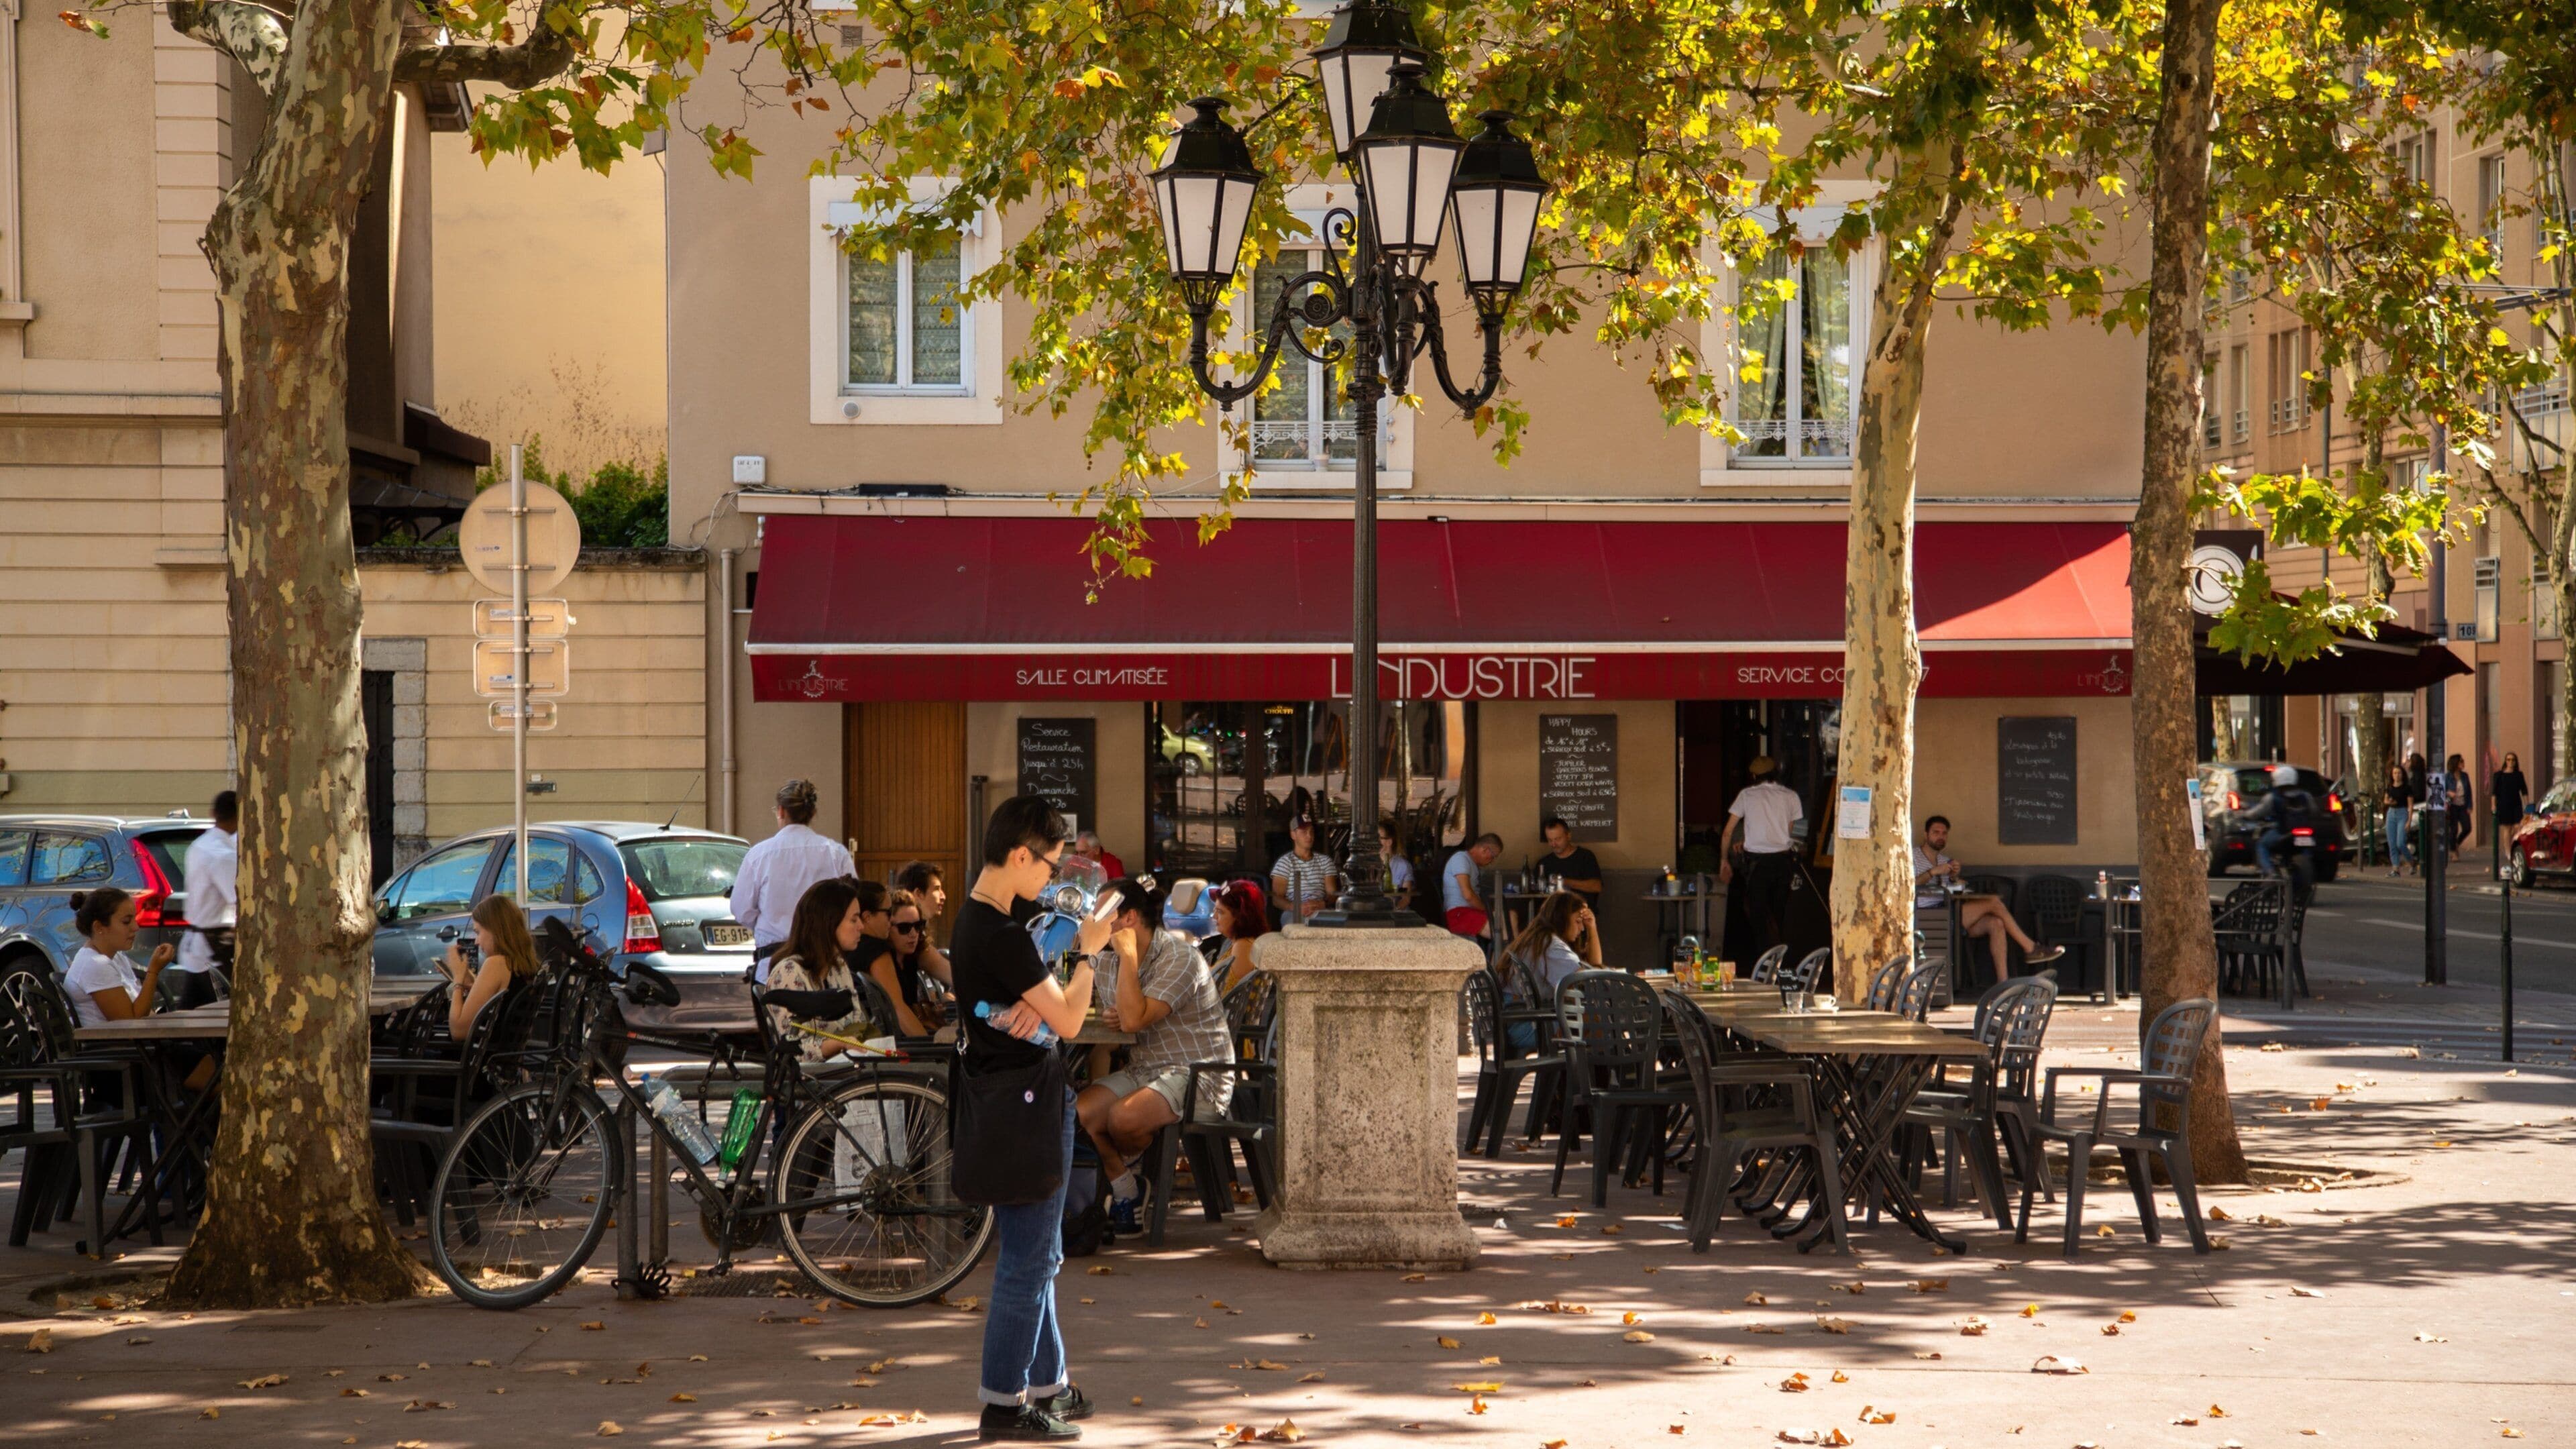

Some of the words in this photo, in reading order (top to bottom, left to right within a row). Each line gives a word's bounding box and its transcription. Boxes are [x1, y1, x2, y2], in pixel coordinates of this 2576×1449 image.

[1016, 669, 1067, 685] SALLE
[1073, 667, 1168, 685] CLIMATISÉE
[1332, 657, 1596, 698] LNDUSTRIE
[1737, 667, 1815, 684] SERVICE
[1031, 723, 1071, 737] Service
[1548, 718, 1571, 727] HAPPY
[1572, 727, 1597, 736] HOURS
[1020, 737, 1084, 753] Restauration
[1026, 782, 1079, 796] Dimanche
[714, 928, 752, 943] EG-915-
